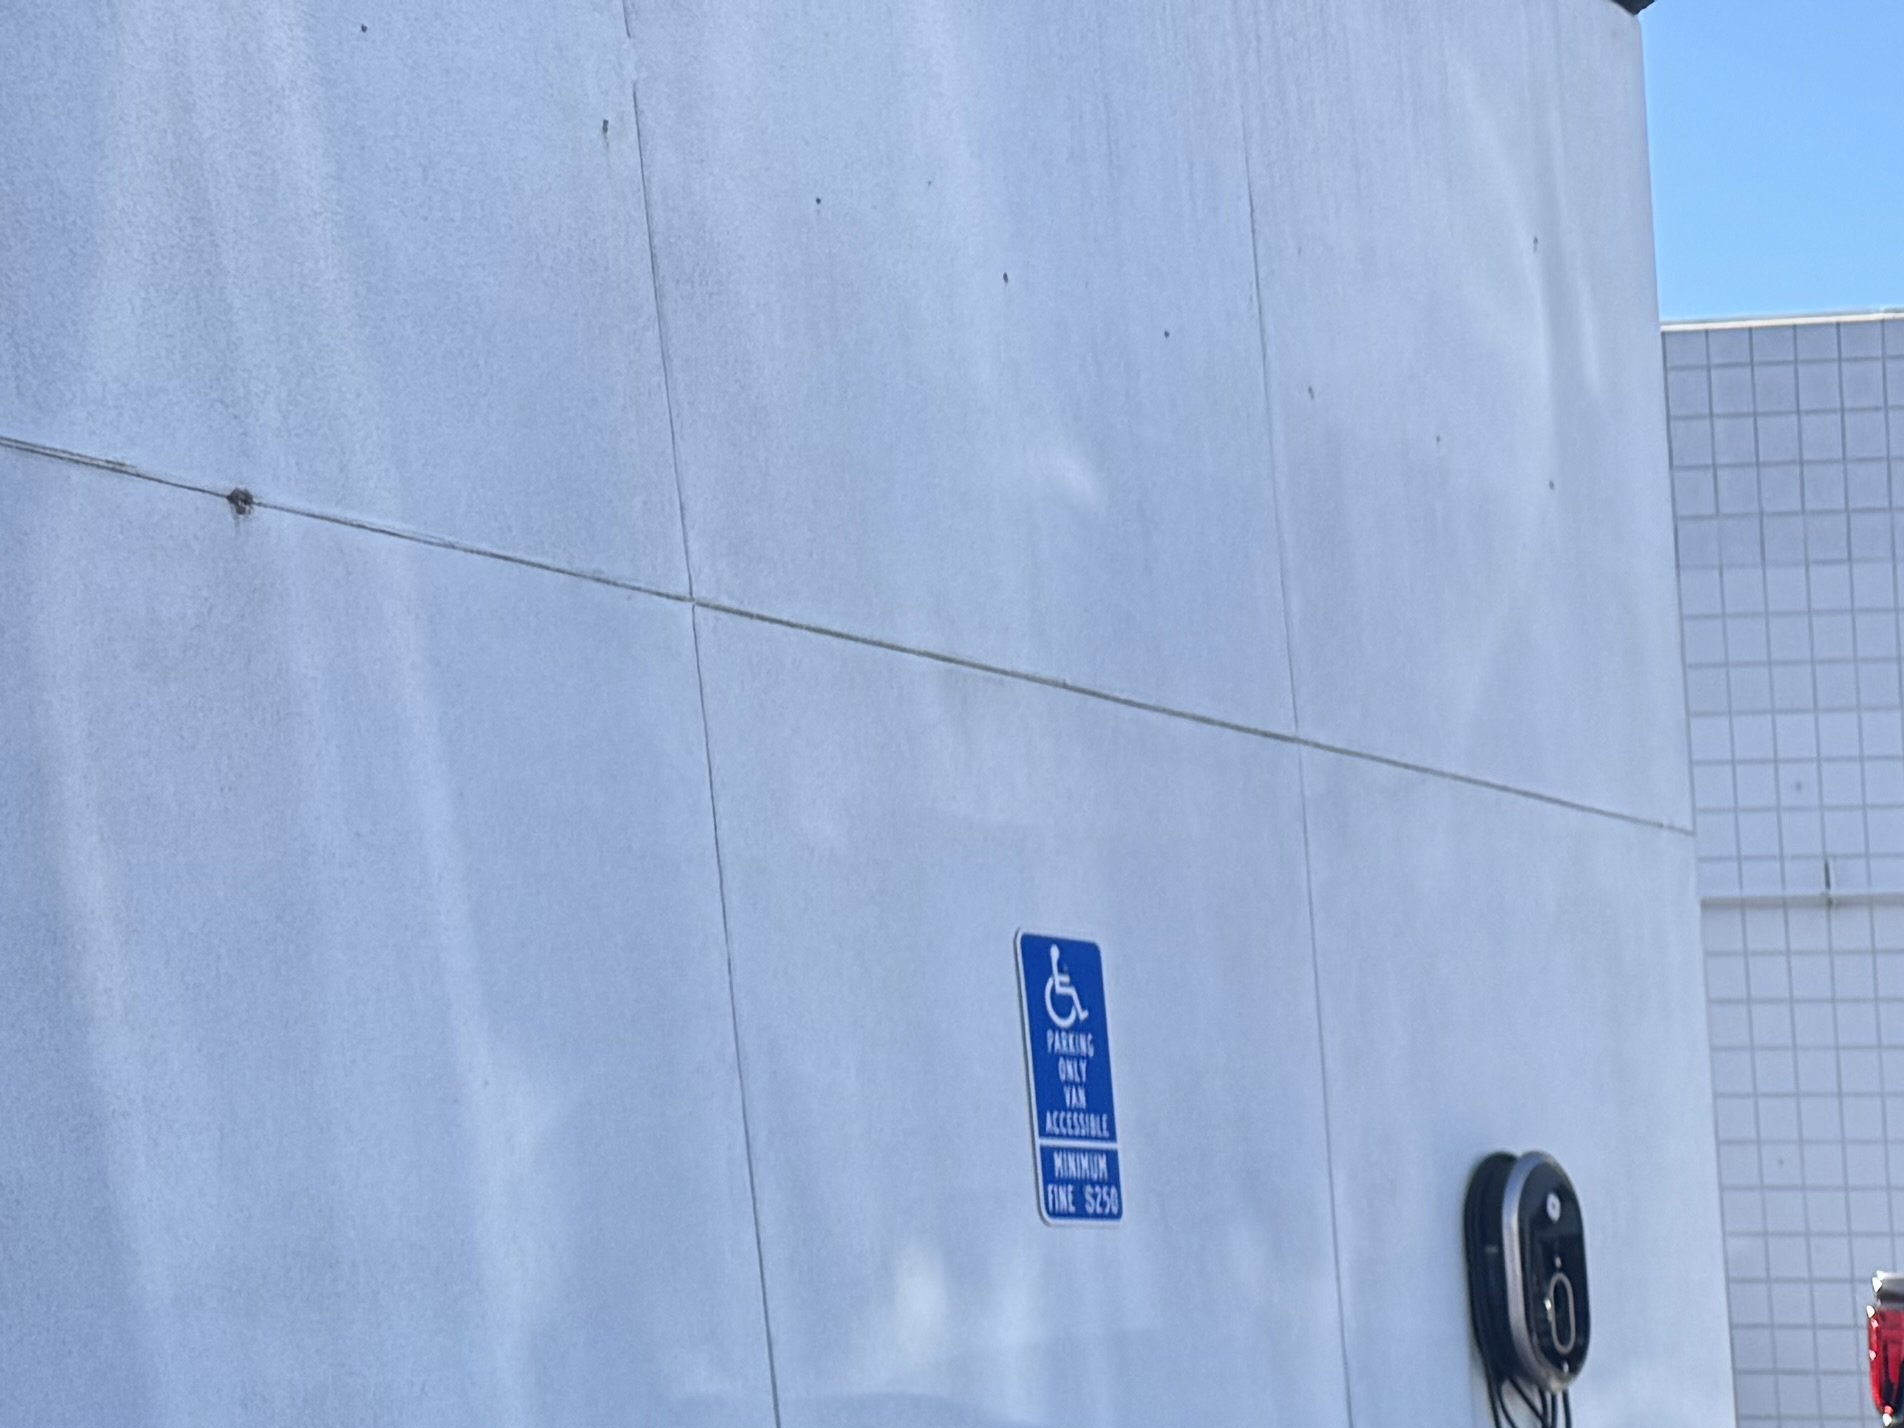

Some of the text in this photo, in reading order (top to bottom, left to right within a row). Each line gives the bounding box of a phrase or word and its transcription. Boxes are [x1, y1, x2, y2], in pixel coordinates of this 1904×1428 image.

[1046, 1029, 1095, 1057] PARKING
[1058, 1057, 1088, 1083] ONLY
[1064, 1086, 1087, 1109] VAN
[1045, 1111, 1110, 1138] ACCESSIBLE
[1053, 1150, 1109, 1181] MINIMUM
[1048, 1184, 1119, 1215] FINE $250
